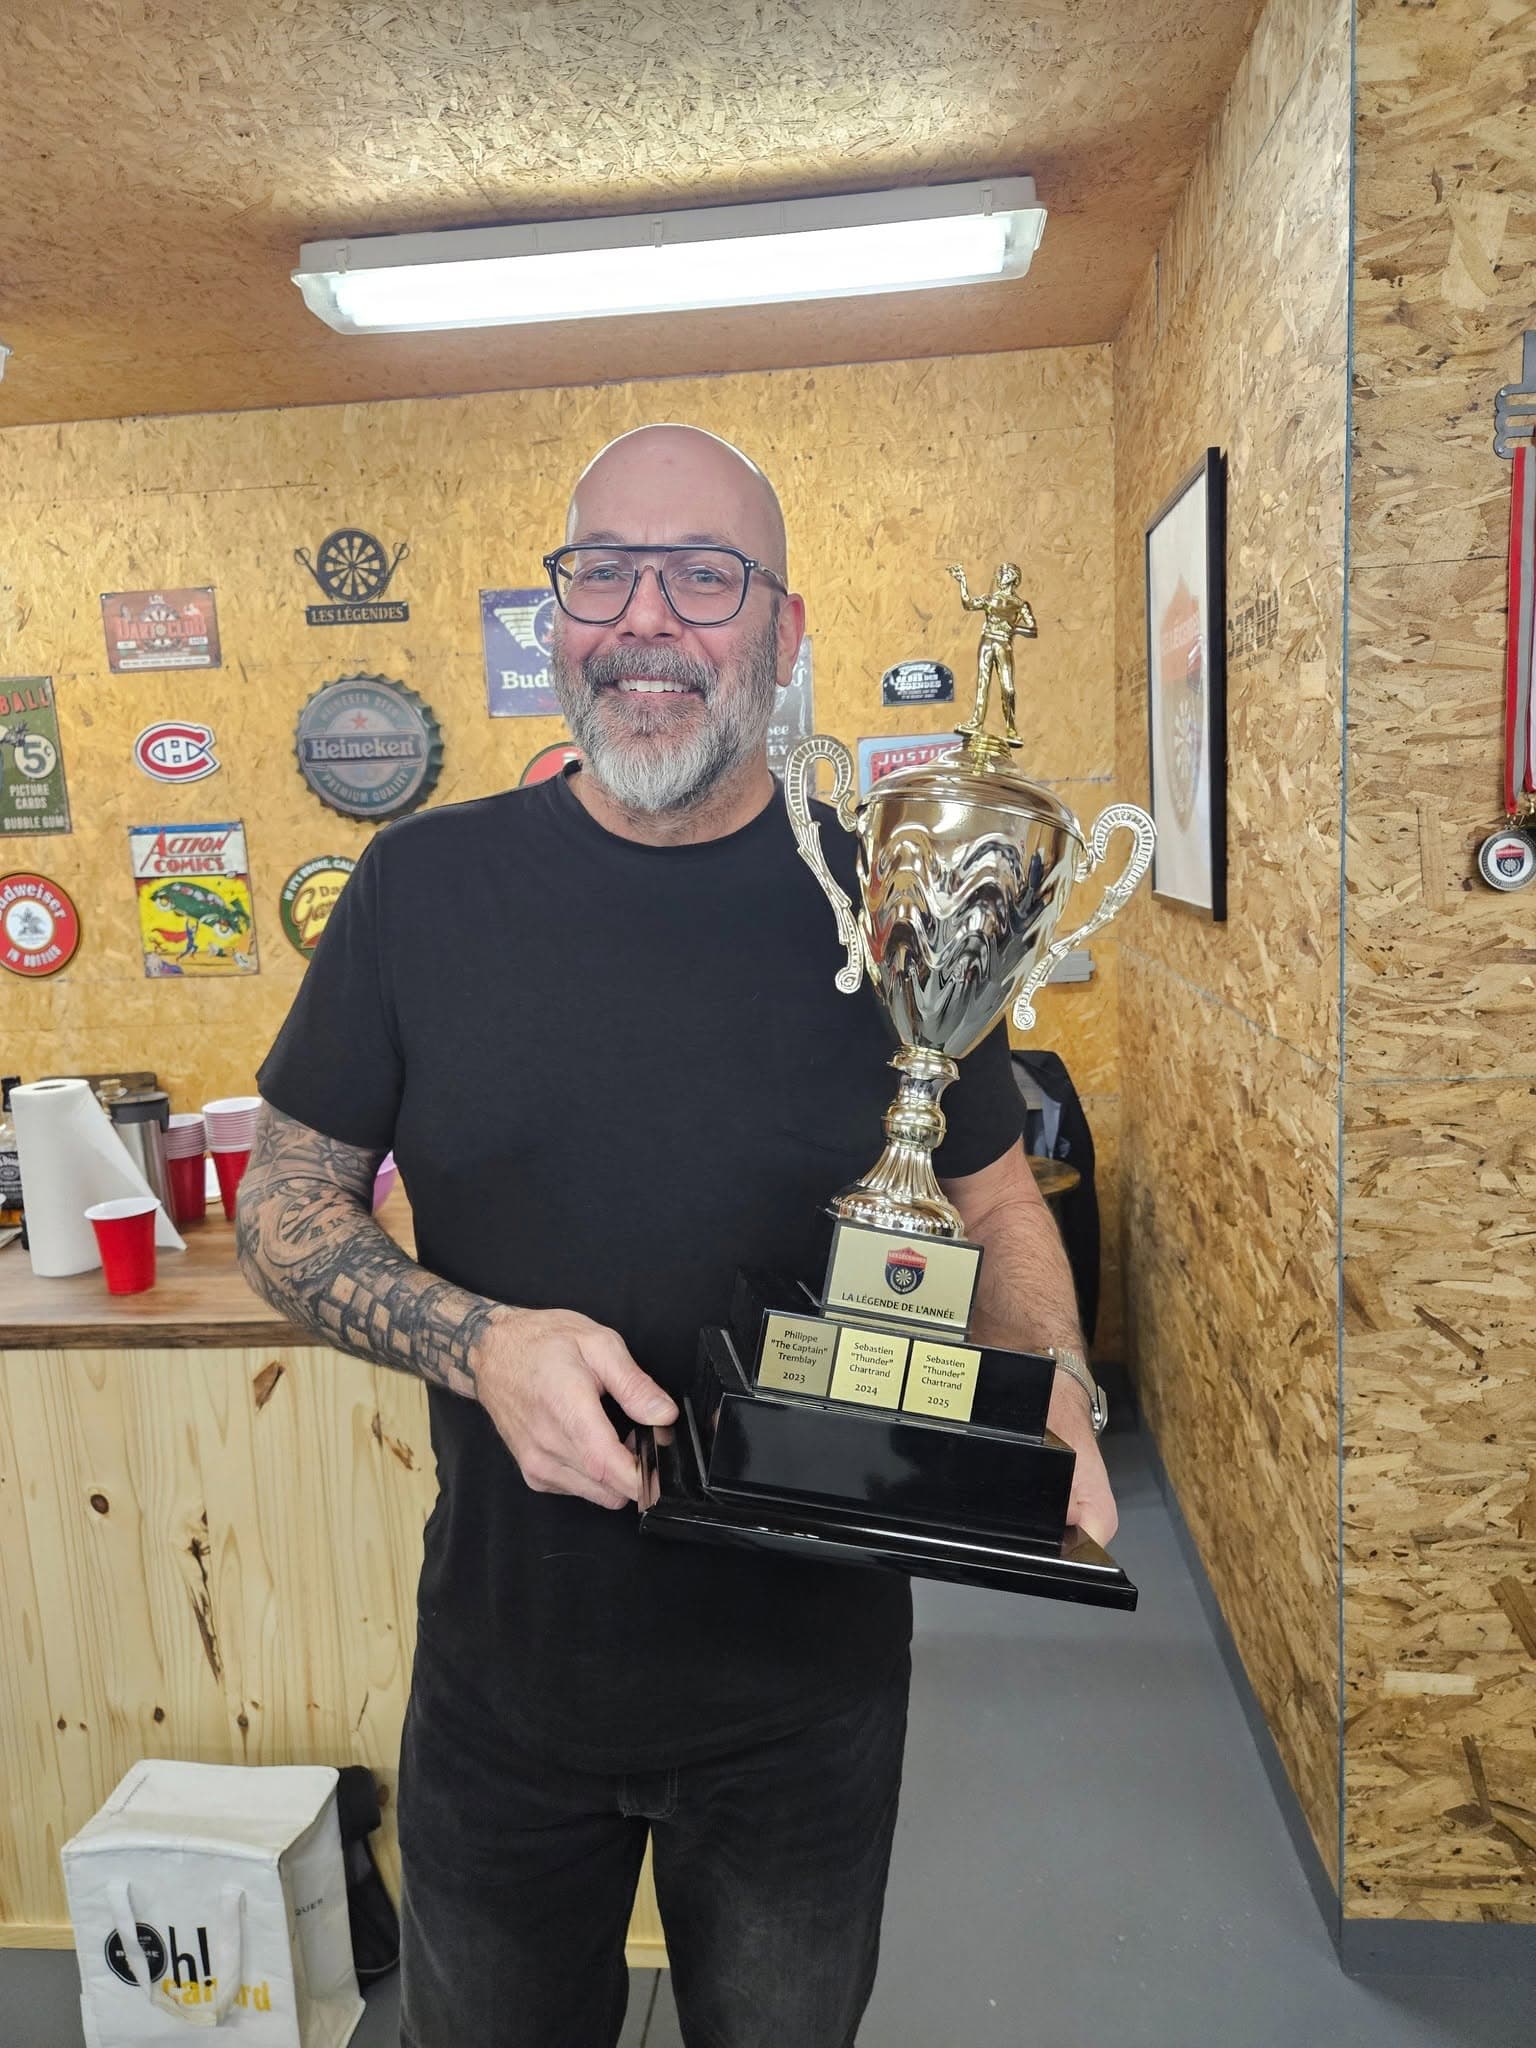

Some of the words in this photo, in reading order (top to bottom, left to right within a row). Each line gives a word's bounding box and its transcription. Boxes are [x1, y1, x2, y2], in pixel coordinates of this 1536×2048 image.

[311, 610, 334, 623] LES
[337, 606, 404, 621] LÉGENDES
[501, 670, 550, 689] Bud
[0, 687, 49, 716] BALL
[310, 736, 416, 760] Heineken
[9, 784, 49, 797] PICTURE
[15, 796, 48, 810] CARDS
[42, 816, 65, 829] GUM
[153, 857, 225, 873] COMICS
[0, 883, 67, 918] udweiser
[841, 1292, 854, 1301] LA
[856, 1294, 899, 1310] LÉGENDE
[901, 1302, 914, 1313] DE
[915, 1306, 956, 1320] L'ANNÉE
[784, 1330, 818, 1343] Philippe
[771, 1339, 791, 1350] "The
[792, 1343, 828, 1355] Captain"
[854, 1342, 894, 1356] Sebastien
[778, 1352, 817, 1367] Tremblay
[850, 1352, 894, 1366] "Thunder"
[926, 1354, 966, 1369] Sebastien
[782, 1371, 806, 1384] 2023
[849, 1364, 891, 1378] Chartrand
[922, 1365, 966, 1379] "Thunder"
[854, 1383, 878, 1396] 2024
[921, 1376, 962, 1390] Chartrand
[927, 1396, 950, 1409] 2025
[161, 1977, 272, 2013] Card
